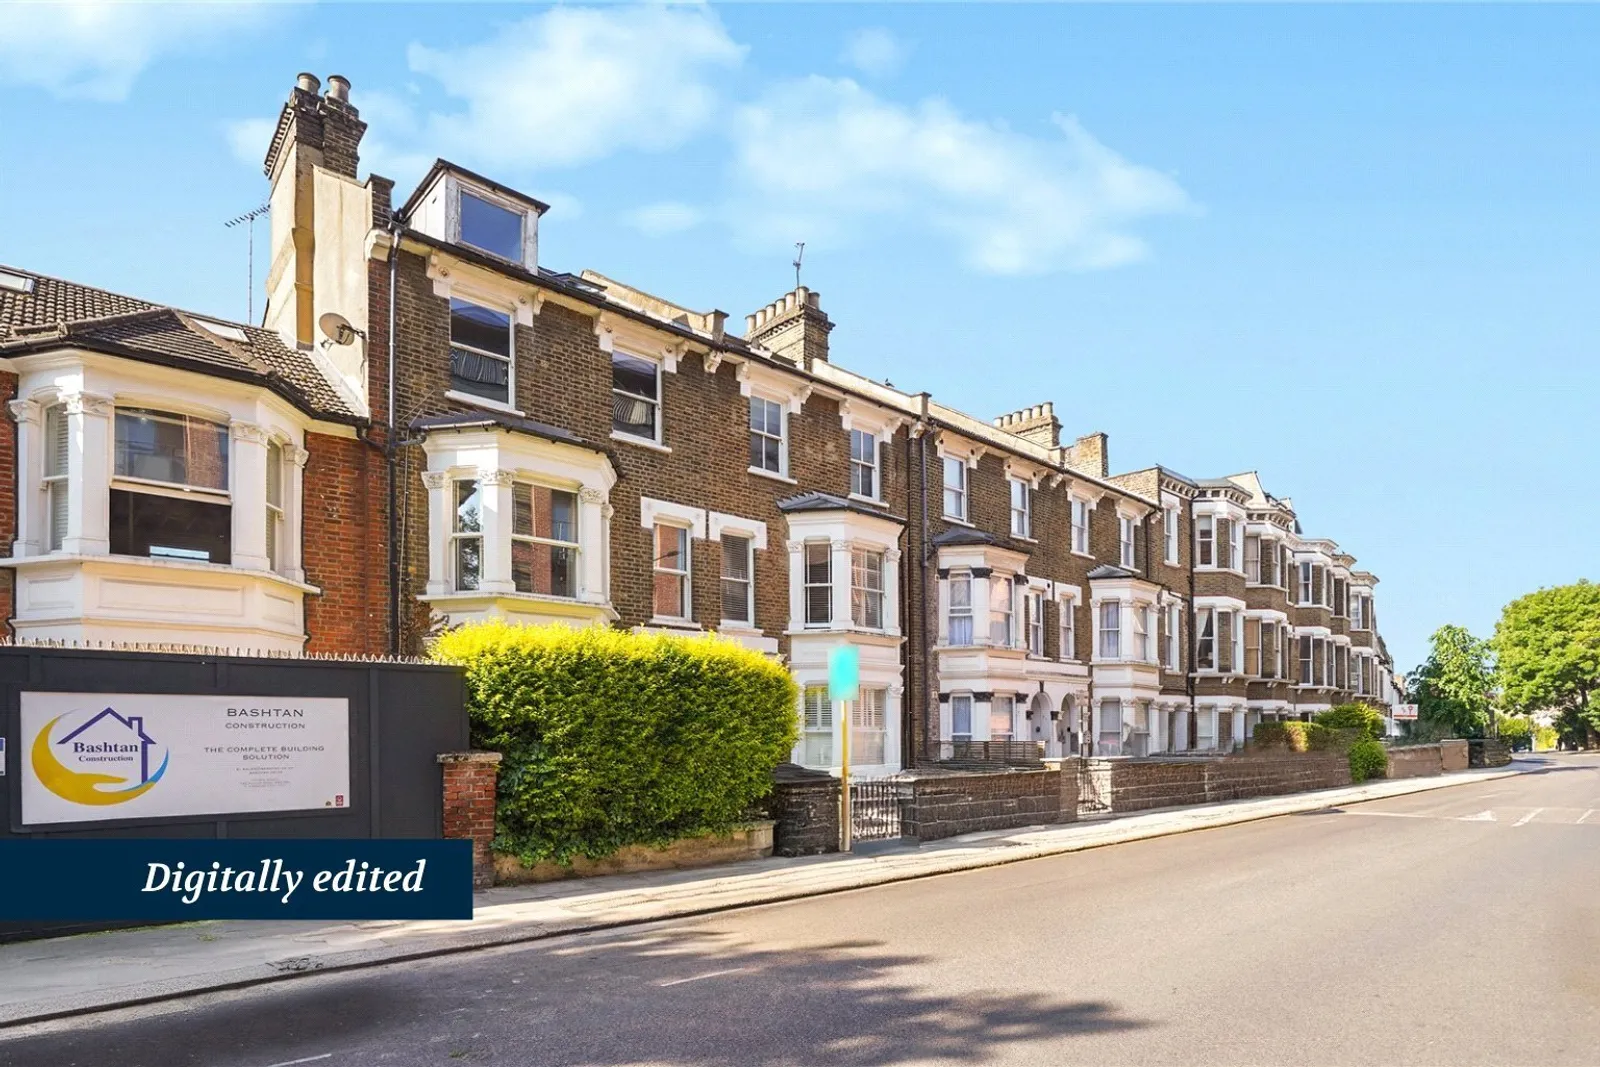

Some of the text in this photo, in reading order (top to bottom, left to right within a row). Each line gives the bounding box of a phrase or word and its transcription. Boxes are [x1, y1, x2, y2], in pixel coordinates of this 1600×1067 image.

[227, 708, 304, 717] BASHTAN
[225, 722, 306, 730] CONSTRUCTION
[73, 741, 138, 753] Bashtan
[204, 746, 224, 754] THE
[281, 745, 325, 753] BUILDING
[78, 755, 134, 763] Construction
[242, 753, 290, 761] SOLUTION
